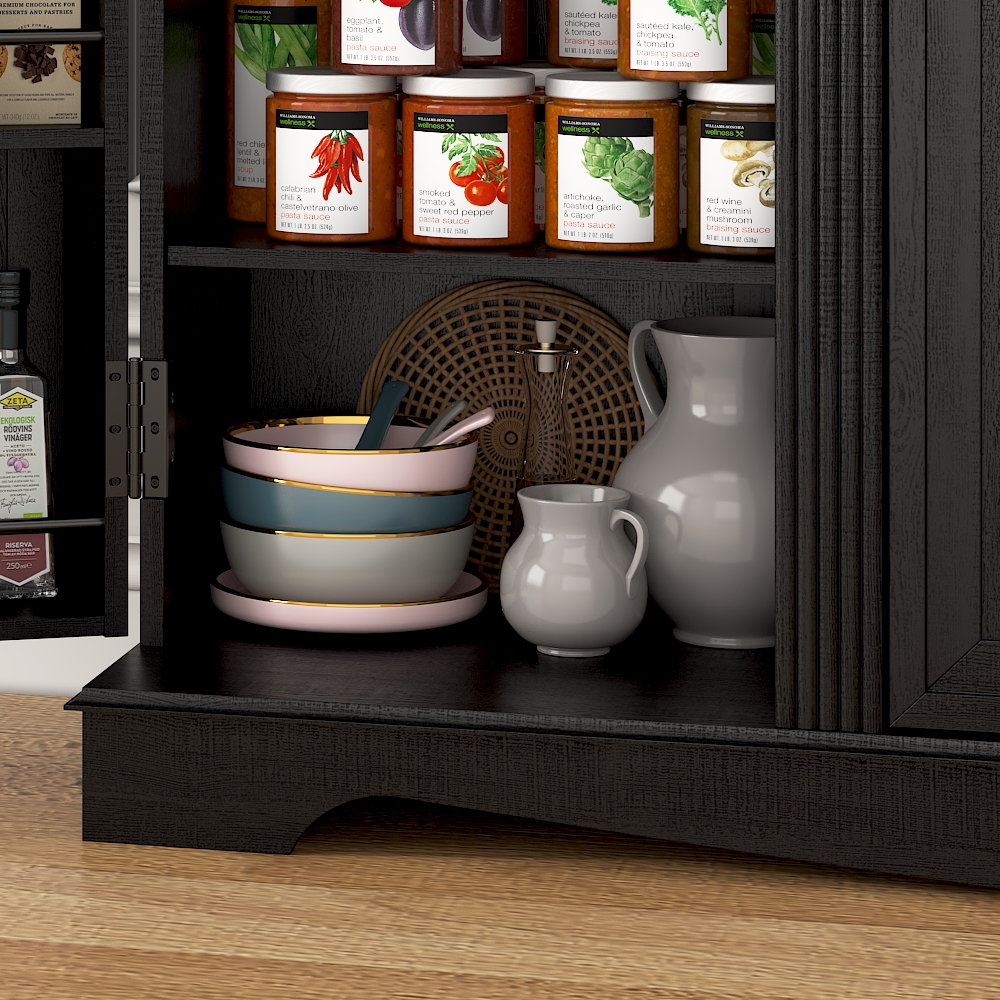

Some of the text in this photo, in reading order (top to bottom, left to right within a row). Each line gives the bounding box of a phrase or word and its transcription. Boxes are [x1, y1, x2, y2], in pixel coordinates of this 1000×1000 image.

[564, 11, 596, 19] sautéed
[346, 16, 384, 26] eggplant,
[564, 19, 600, 28] chickpea
[346, 25, 374, 34] tomato
[636, 22, 694, 31] sautéed kale,
[564, 28, 601, 37] & tomato
[636, 31, 674, 40] chickpea
[346, 34, 364, 42] basil
[564, 37, 595, 46] braising
[346, 43, 397, 52] pasta sauce
[643, 40, 674, 48] tomato
[636, 49, 700, 58] braising sauce
[281, 185, 316, 193] calabrian
[419, 189, 451, 197] smoked
[281, 193, 295, 201] chili
[563, 193, 604, 202] artichoke,
[706, 196, 719, 204] red
[281, 202, 336, 211] castelvetrano
[419, 198, 456, 207] tomato &
[563, 202, 622, 212] roasted garlic
[419, 207, 441, 215] sweet
[461, 208, 495, 217] pepper
[563, 210, 595, 220] & caper
[714, 206, 752, 215] creamini
[303, 213, 331, 221] sauce
[419, 216, 470, 225] pasta sauce
[706, 215, 753, 224] mushroom
[563, 220, 616, 229] pasta sauce
[706, 224, 739, 234] braising
[7, 397, 28, 405] ZETA
[0, 416, 35, 425] EKOLOGISK
[3, 424, 33, 433] RÖDVINS
